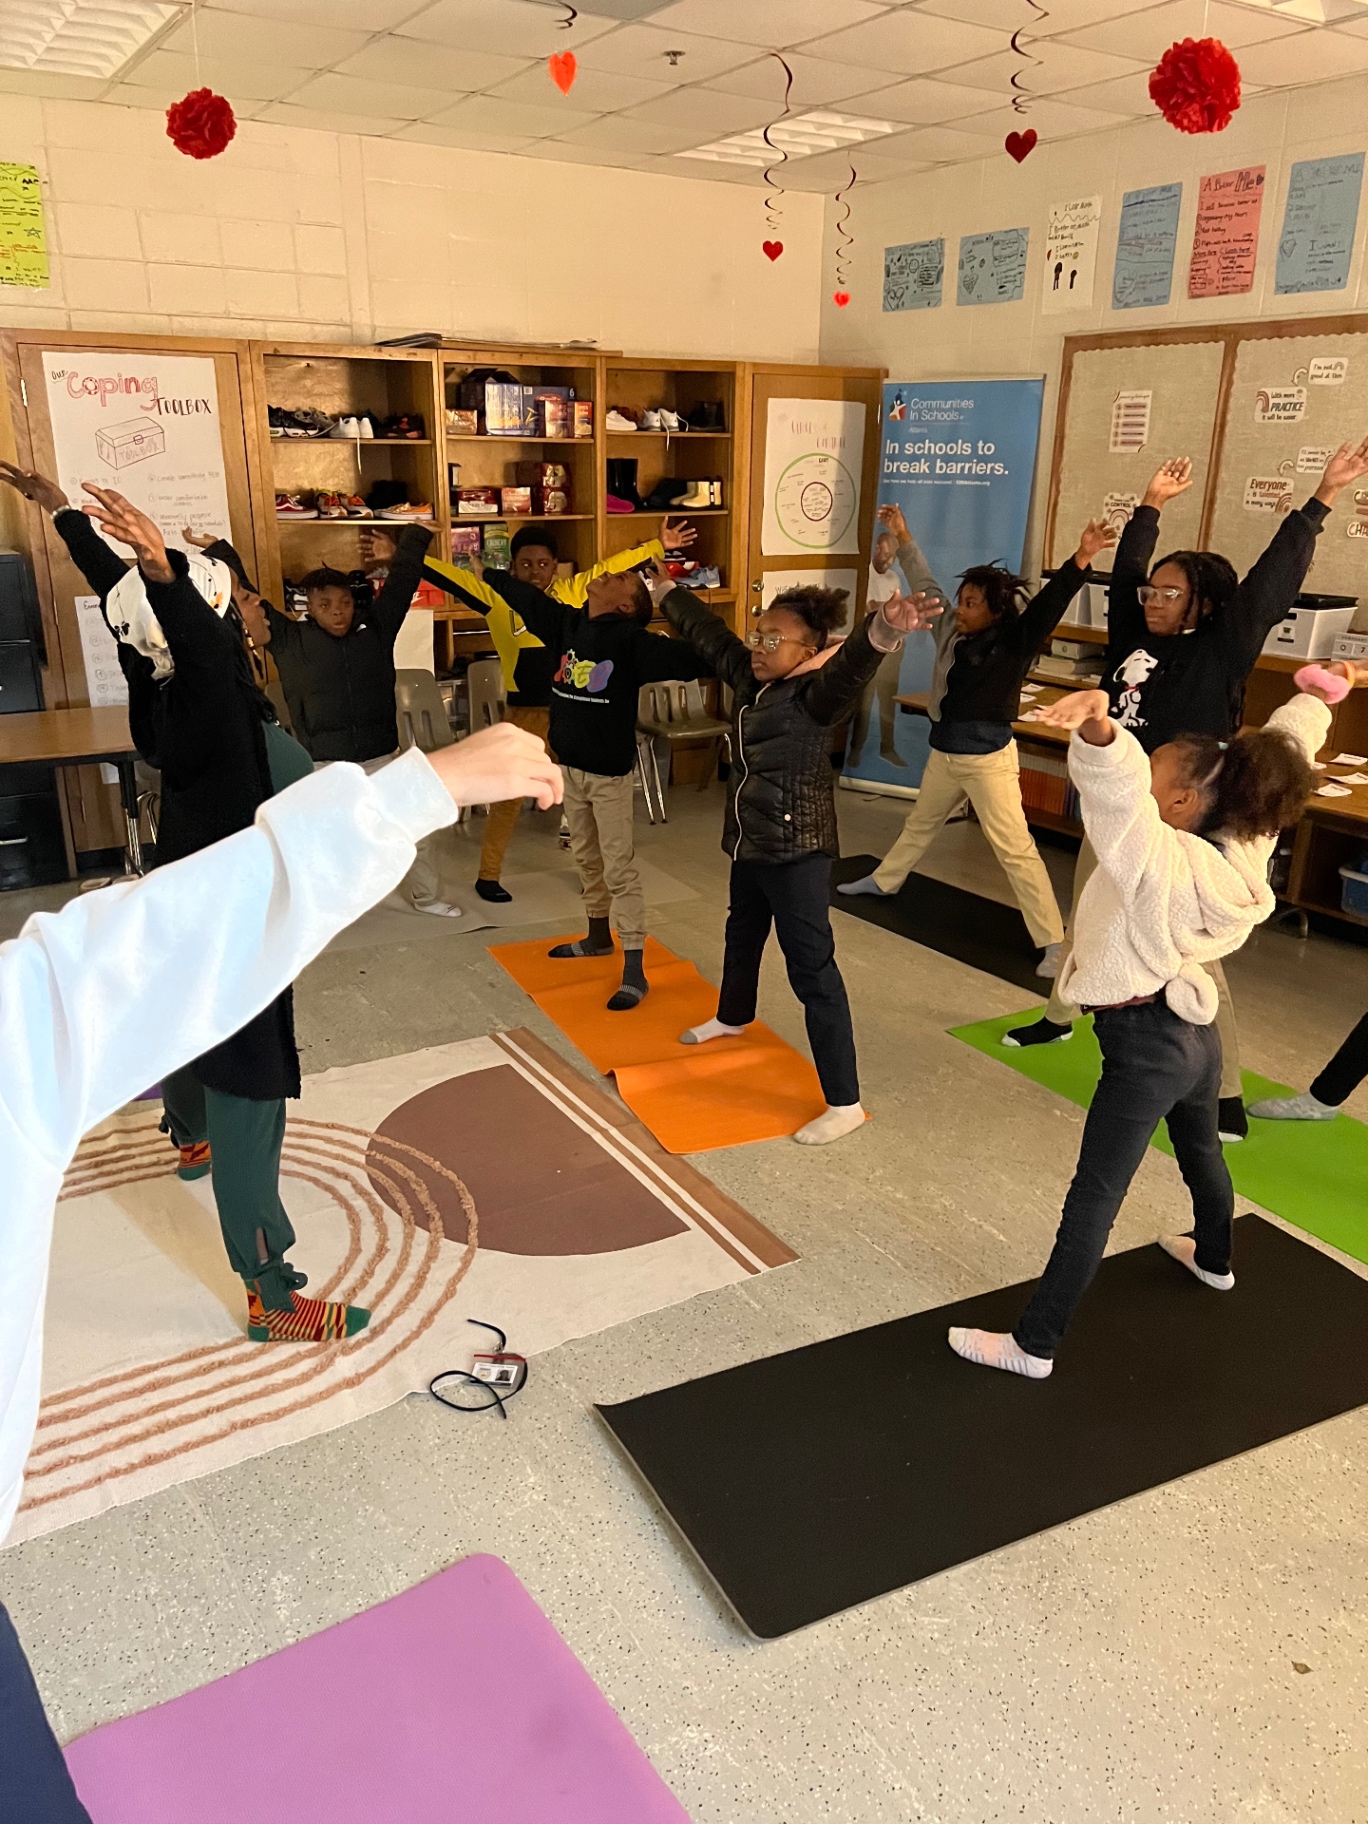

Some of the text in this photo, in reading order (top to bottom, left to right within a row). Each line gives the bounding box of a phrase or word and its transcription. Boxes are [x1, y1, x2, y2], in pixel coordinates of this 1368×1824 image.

[66, 371, 157, 411] Coping
[150, 397, 211, 415] TOOLBOX
[911, 398, 975, 409] Communities
[1270, 402, 1304, 411] PRACTICE
[909, 410, 918, 420] In
[885, 439, 995, 454] In schools to
[884, 458, 1009, 475] break barriers.
[1250, 478, 1287, 491] Everyone
